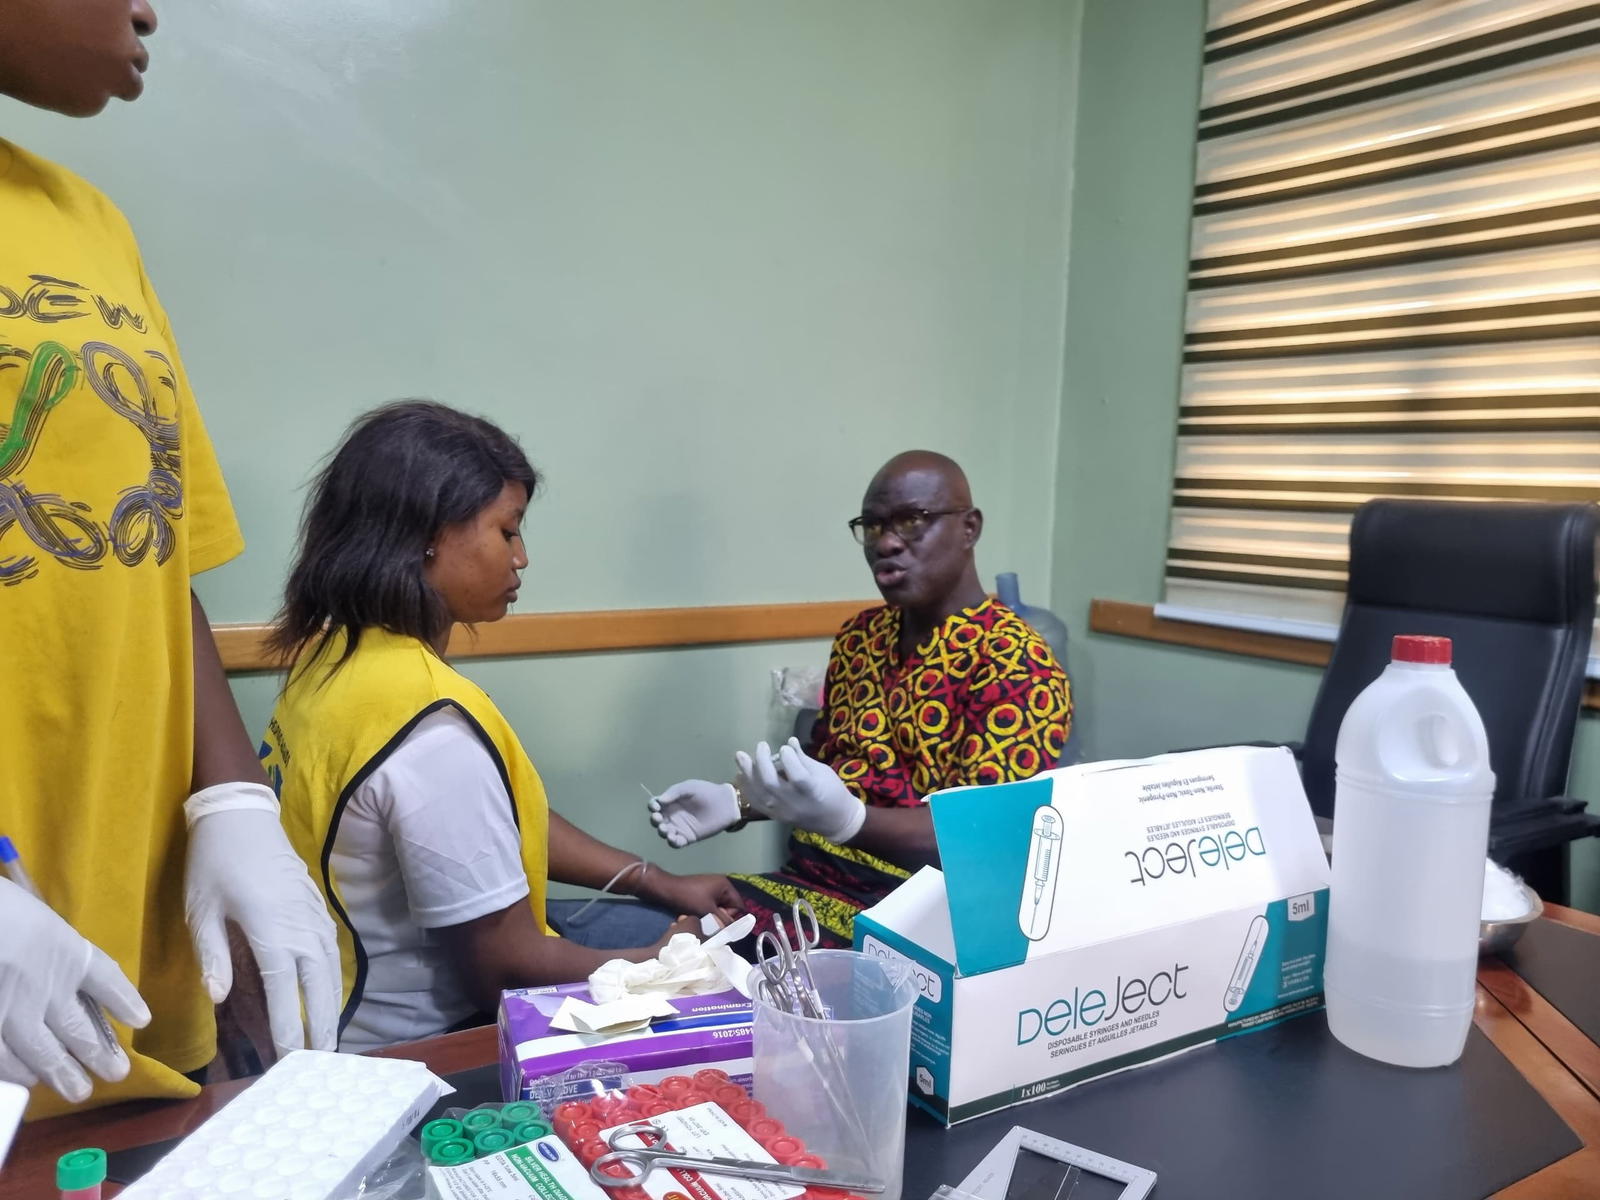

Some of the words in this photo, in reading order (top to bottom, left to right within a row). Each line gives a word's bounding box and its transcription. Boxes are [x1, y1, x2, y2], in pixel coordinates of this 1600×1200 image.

[1197, 816, 1205, 824] ET
[1206, 819, 1236, 831] DISPOSABLE
[1146, 822, 1171, 833] JETABLES
[1170, 828, 1181, 836] AND
[1181, 823, 1206, 834] SYRINGES
[1147, 831, 1170, 842] NEEDLES
[1292, 899, 1310, 915] 5ml
[692, 1002, 753, 1012] Examination
[1047, 1031, 1088, 1050] DISPOSABLE
[1088, 1022, 1120, 1038] SYRINGES
[1120, 1018, 1133, 1029] AND
[1133, 1010, 1160, 1025] NEEDLES
[1050, 1042, 1088, 1058] SERINGUES
[1088, 1040, 1097, 1048] ET
[1097, 1030, 1128, 1046] AIGUILLES
[1128, 1019, 1158, 1035] JETABLES
[1021, 1081, 1046, 1098] 1x100
